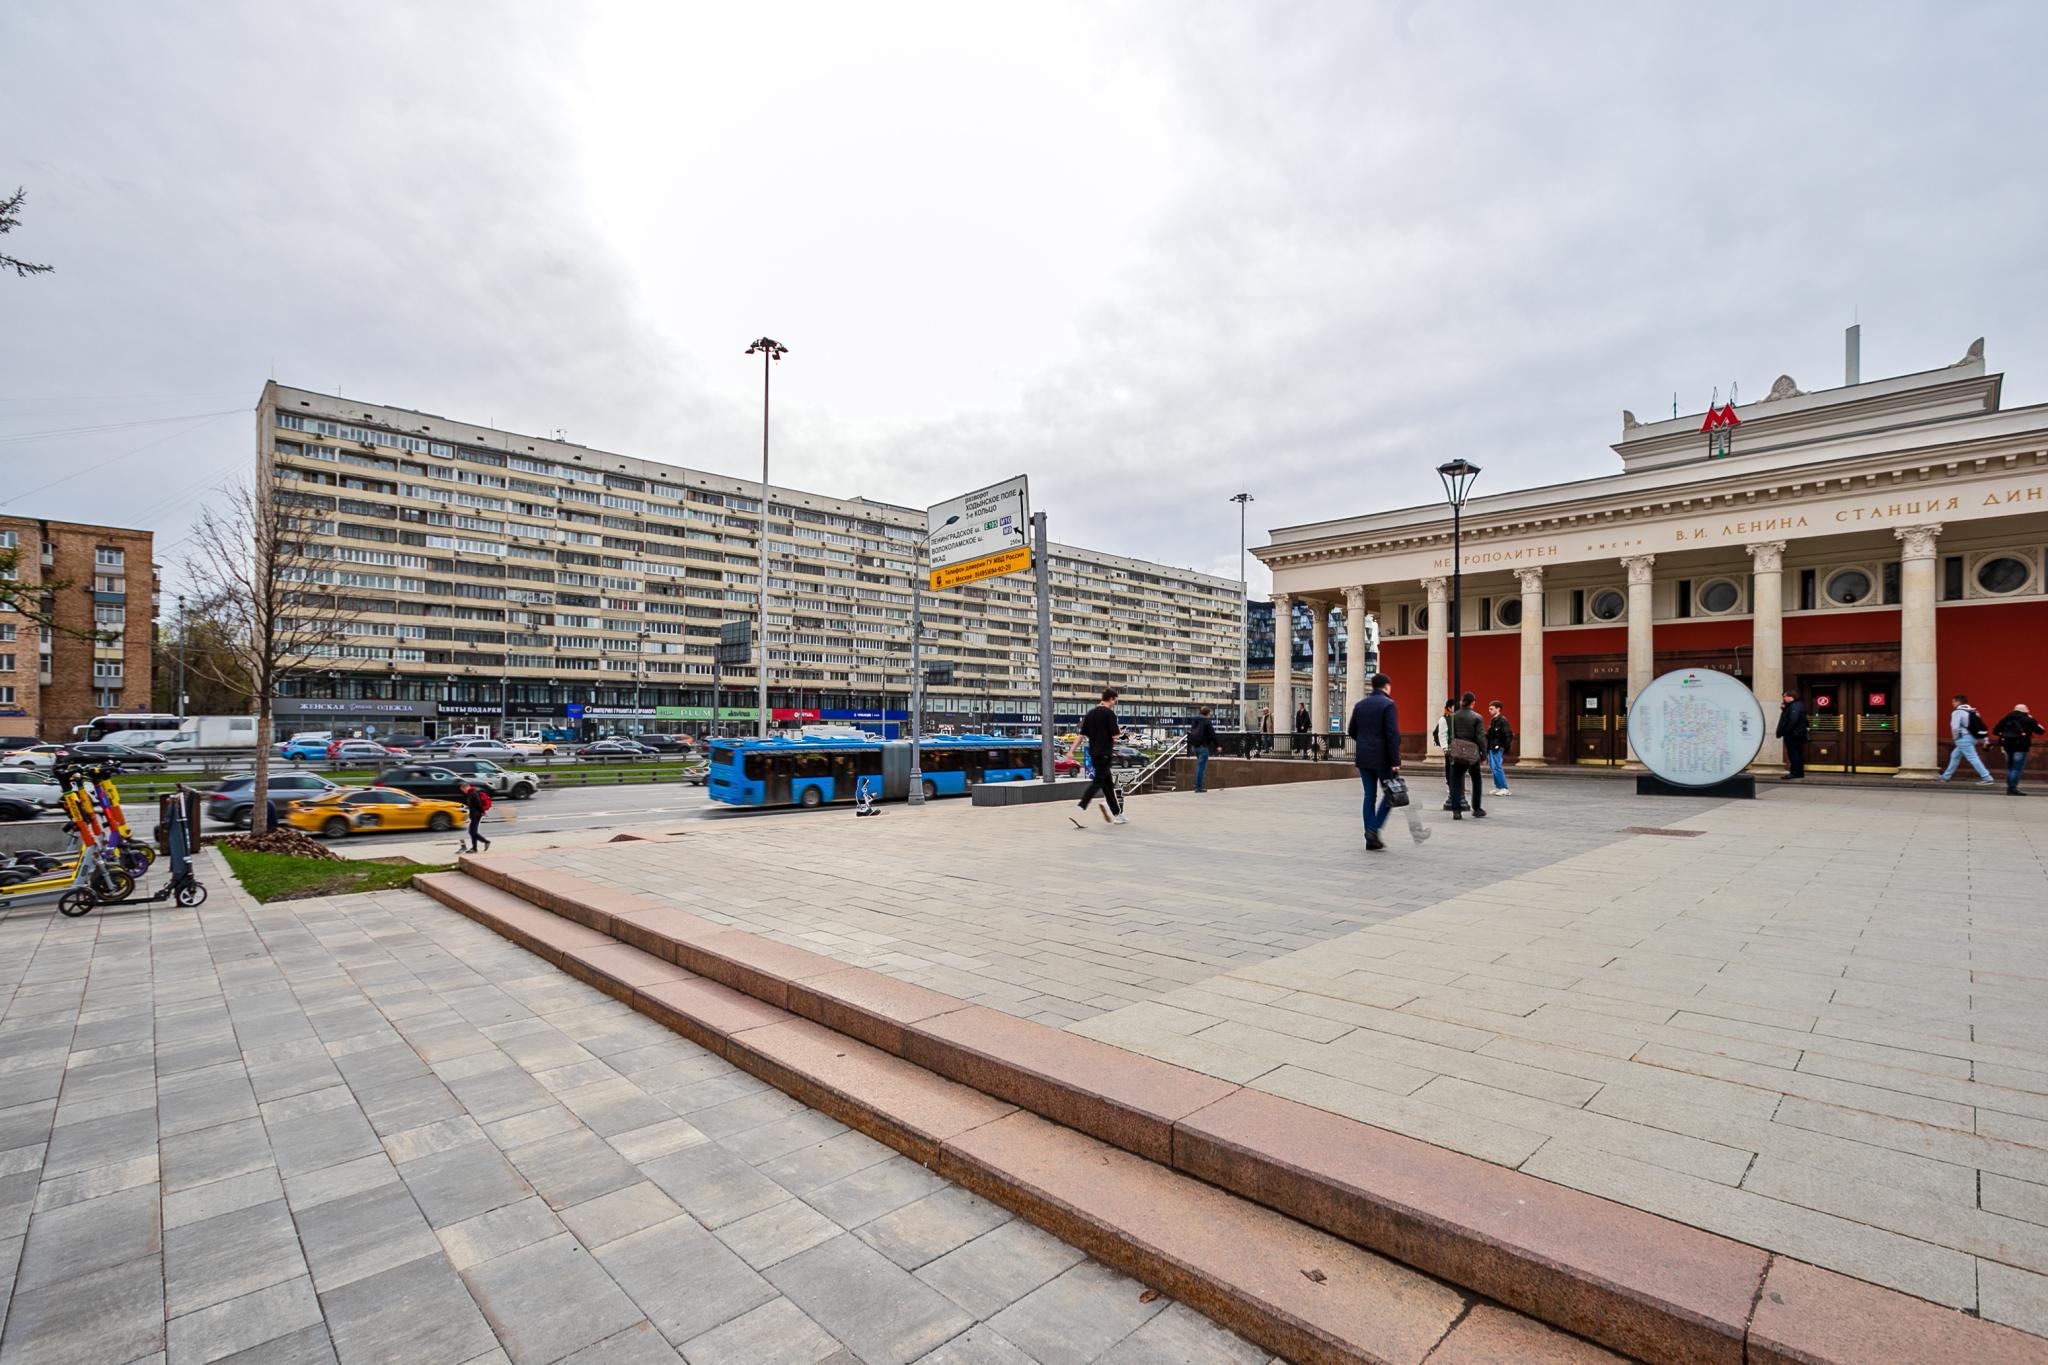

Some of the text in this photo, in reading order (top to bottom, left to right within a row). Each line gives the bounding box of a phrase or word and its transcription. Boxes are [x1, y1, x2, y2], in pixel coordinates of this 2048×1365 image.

[966, 489, 1017, 511] ХОДЫНСКОЕ ПОЛЕ
[974, 505, 997, 517] КОЛЬЦО
[1433, 545, 1558, 569] МЕРОПОЛИТЕН
[1722, 516, 1808, 535] ЛЕНИНА
[1836, 497, 1959, 522] СТАНЦИЯ
[1982, 487, 2043, 506] ДИН
[994, 555, 1005, 564] МВД
[1006, 552, 1024, 561] России
